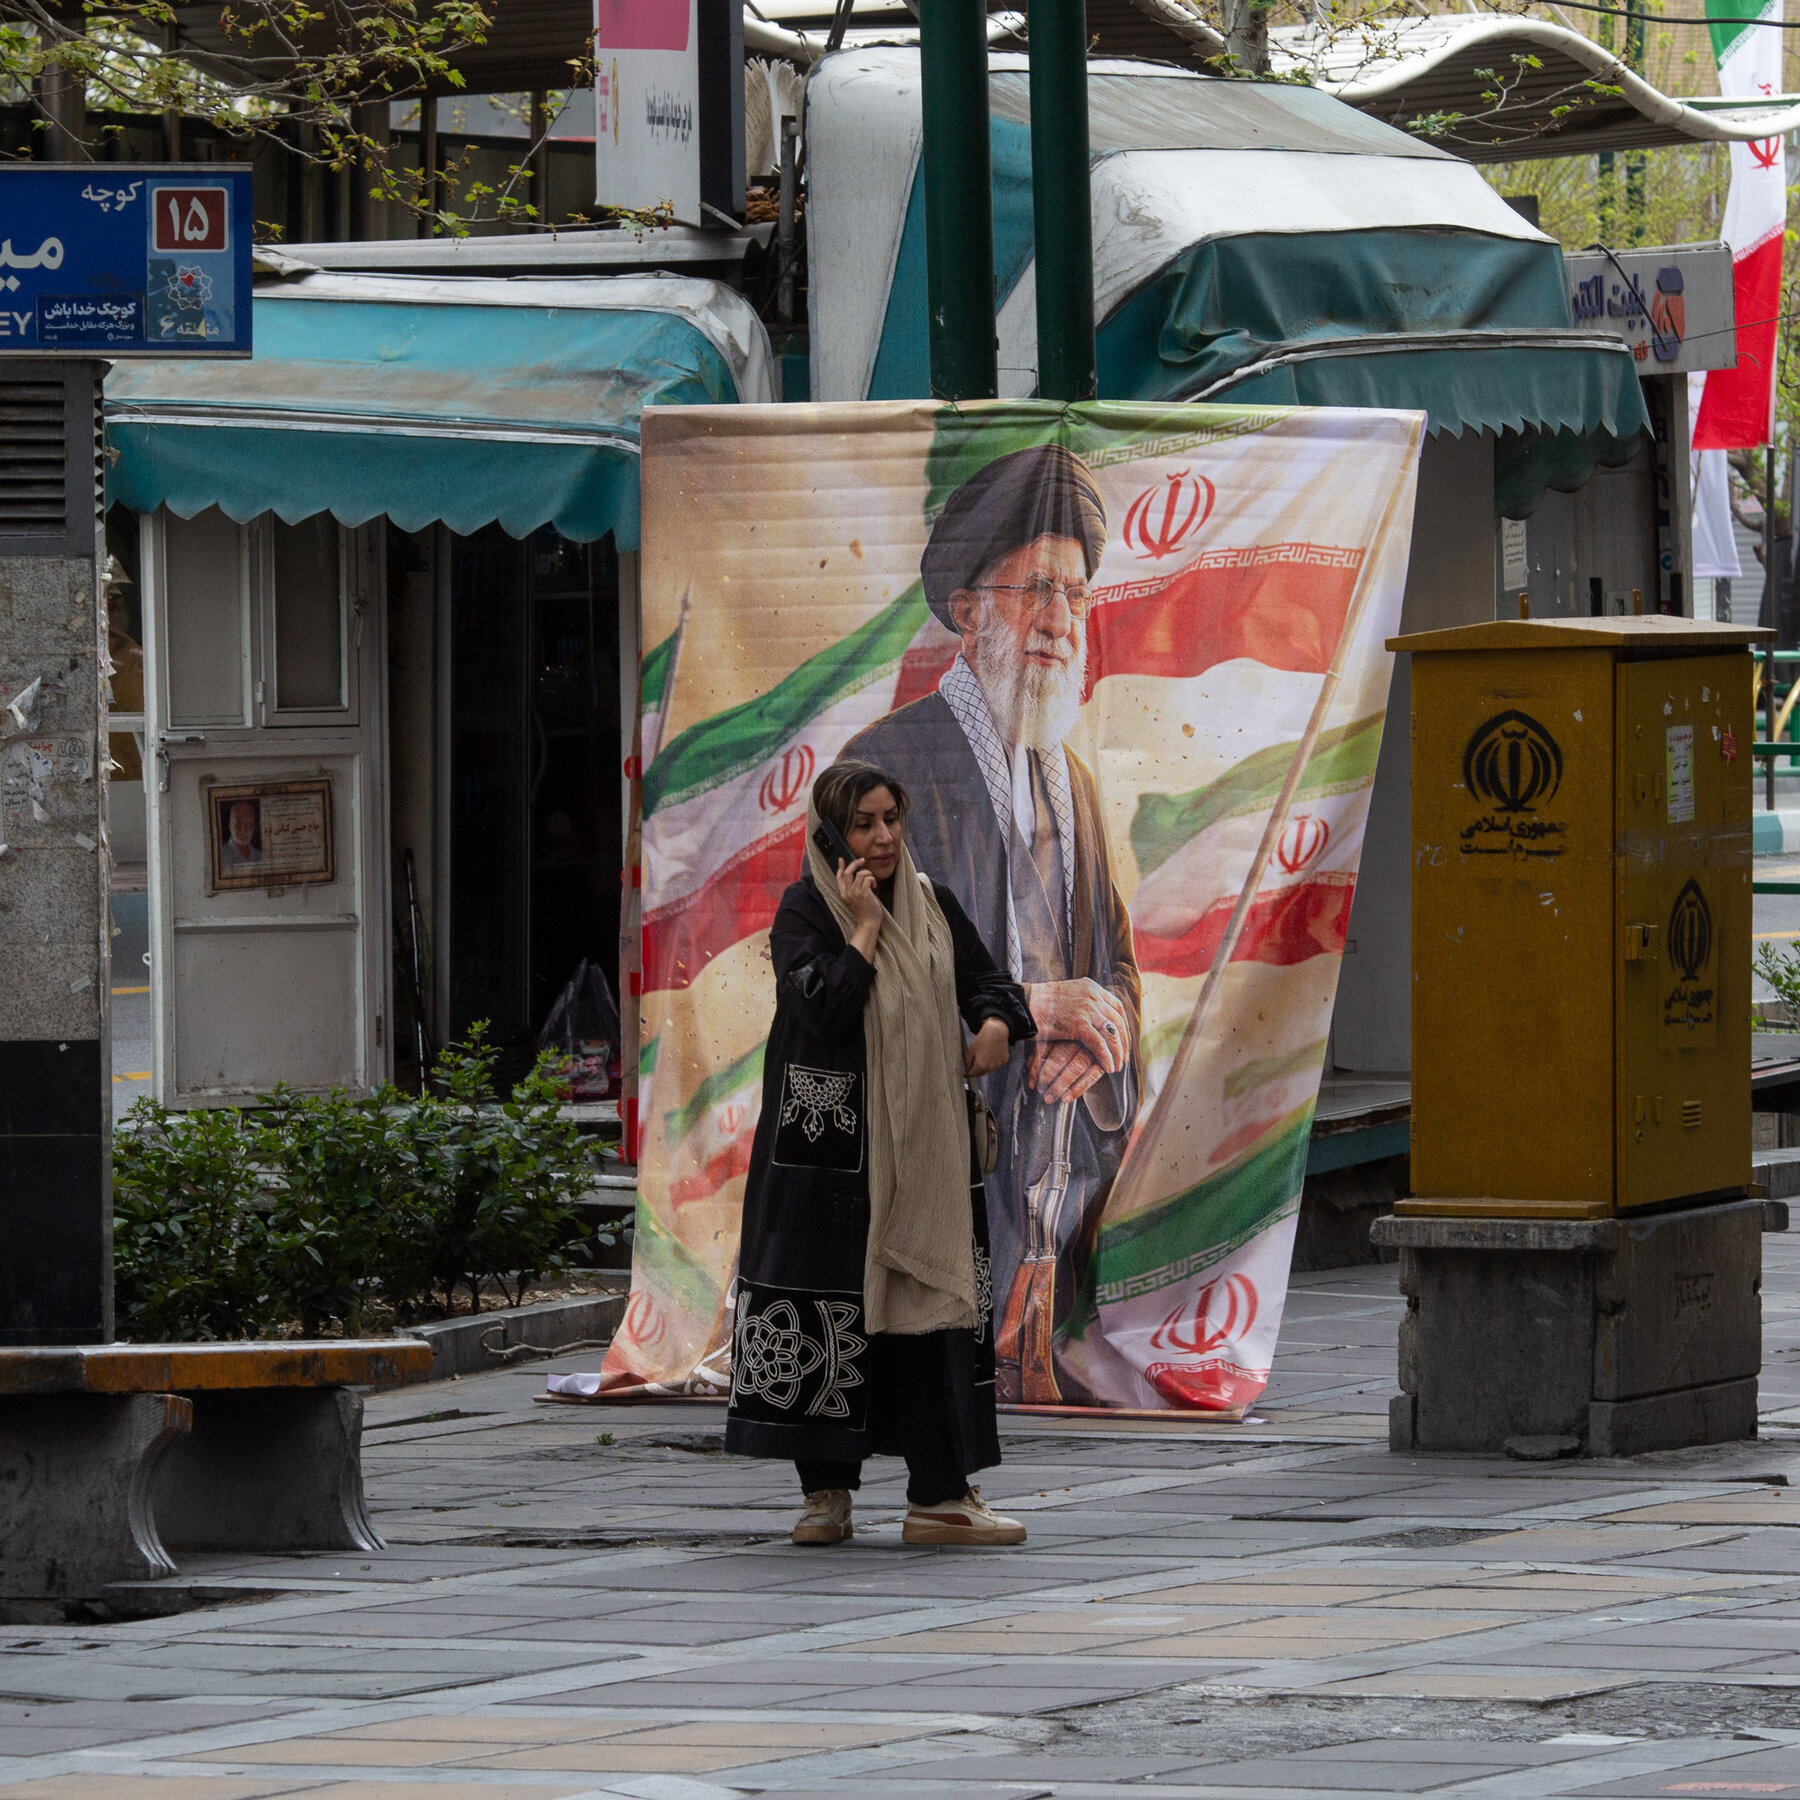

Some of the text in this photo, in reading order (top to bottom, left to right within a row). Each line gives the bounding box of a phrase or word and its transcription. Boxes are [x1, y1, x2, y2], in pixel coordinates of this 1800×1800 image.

[81, 181, 143, 212] کوچه
[168, 196, 210, 242] ۱۵
[44, 302, 137, 320] کوچک خدا باش
[1607, 273, 1647, 329] بلیت
[79, 321, 97, 331] مقابل
[115, 321, 130, 331] بزرگ
[160, 314, 175, 337] ۶
[1460, 815, 1511, 839] اسلامی
